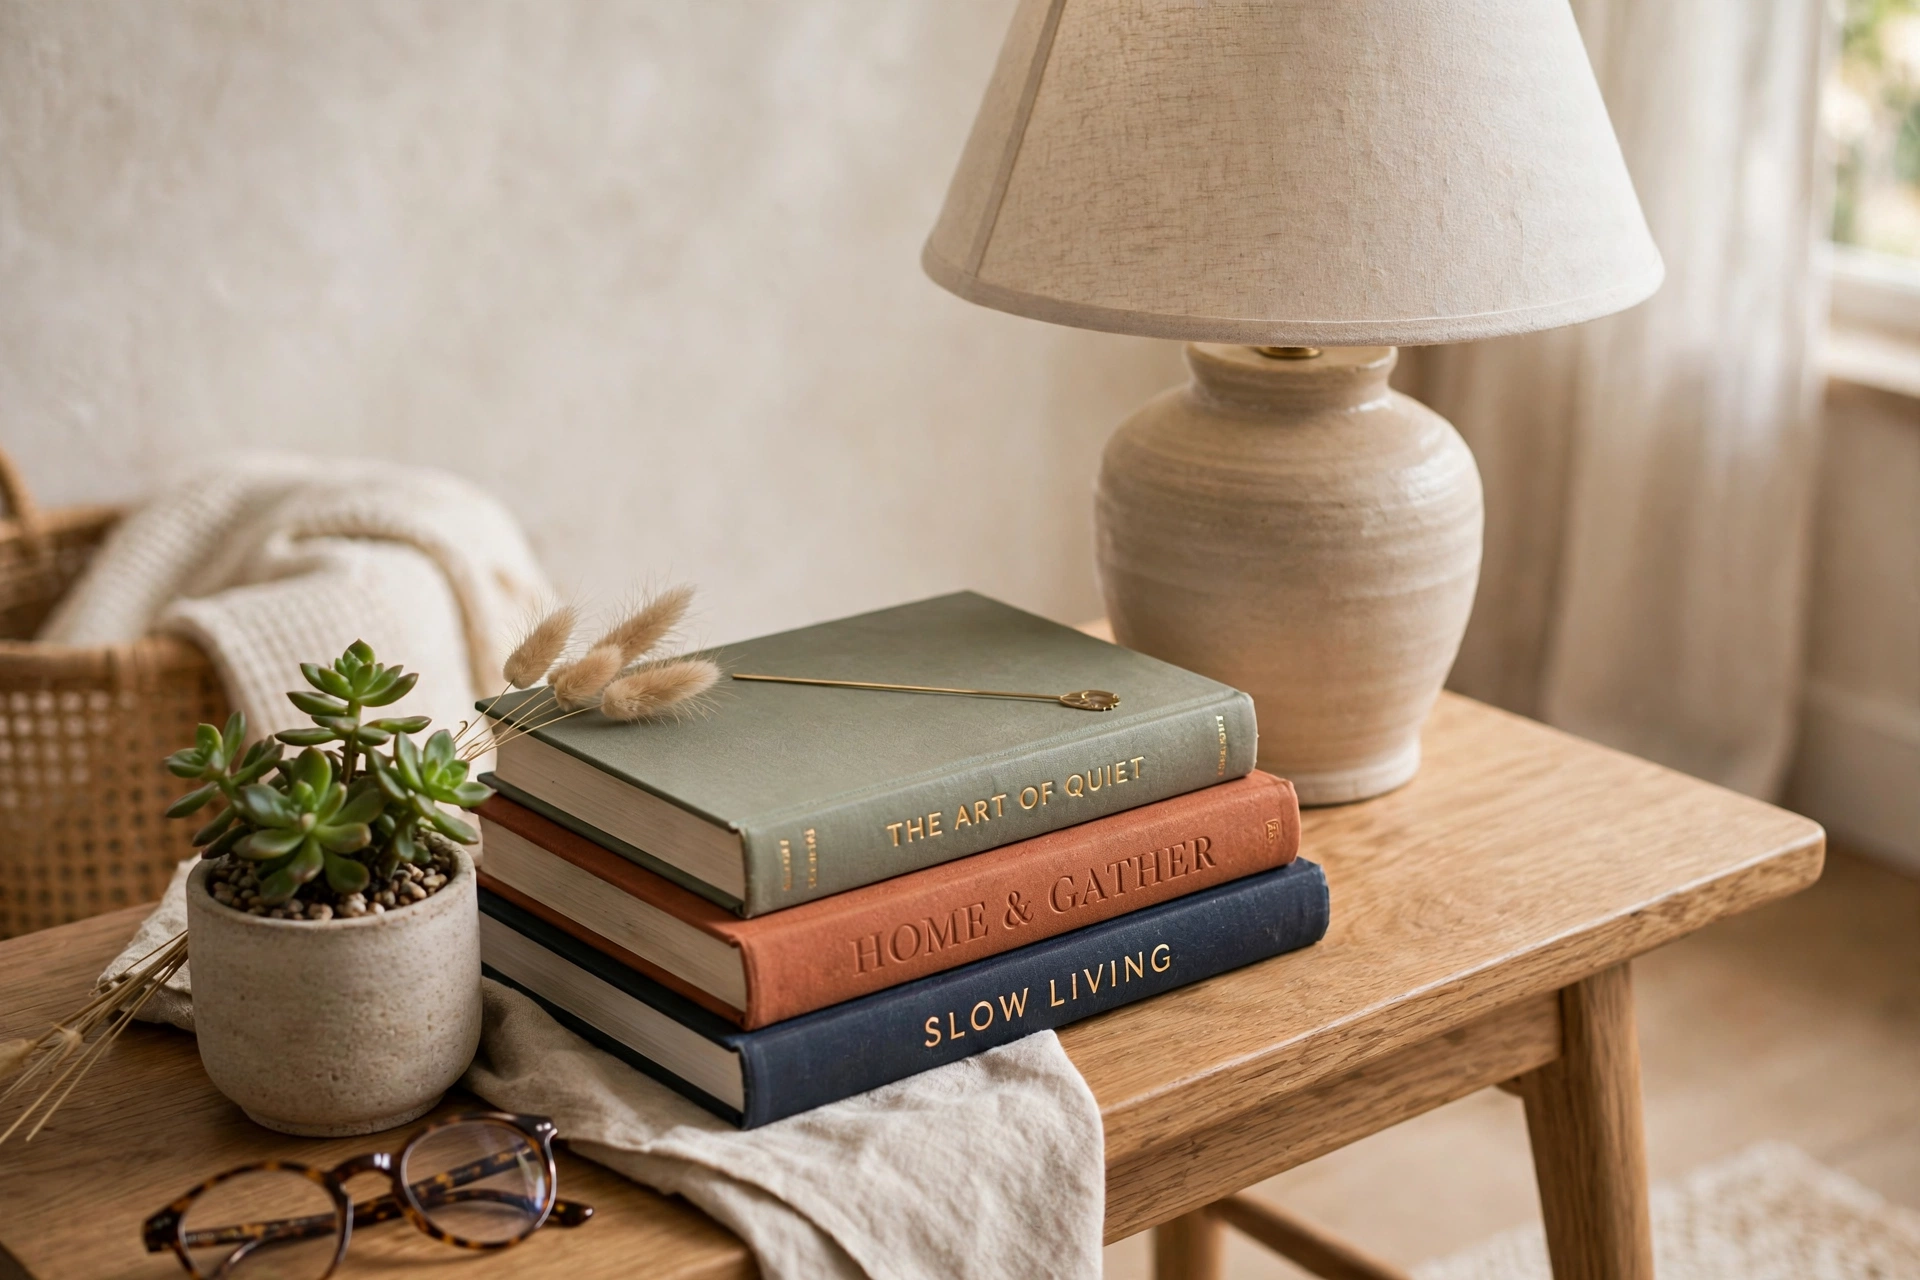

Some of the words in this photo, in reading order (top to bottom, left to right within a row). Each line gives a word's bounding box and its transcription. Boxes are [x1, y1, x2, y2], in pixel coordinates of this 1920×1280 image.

[887, 812, 942, 847] THE
[955, 794, 1007, 831] ART
[1020, 782, 1053, 811] OF
[1065, 756, 1145, 798] QUIET
[850, 901, 990, 977] HOME
[1002, 890, 1034, 930] &
[1047, 835, 1217, 915] GATHER
[924, 987, 1030, 1048] SLOW
[1049, 943, 1171, 1007] LIVING
